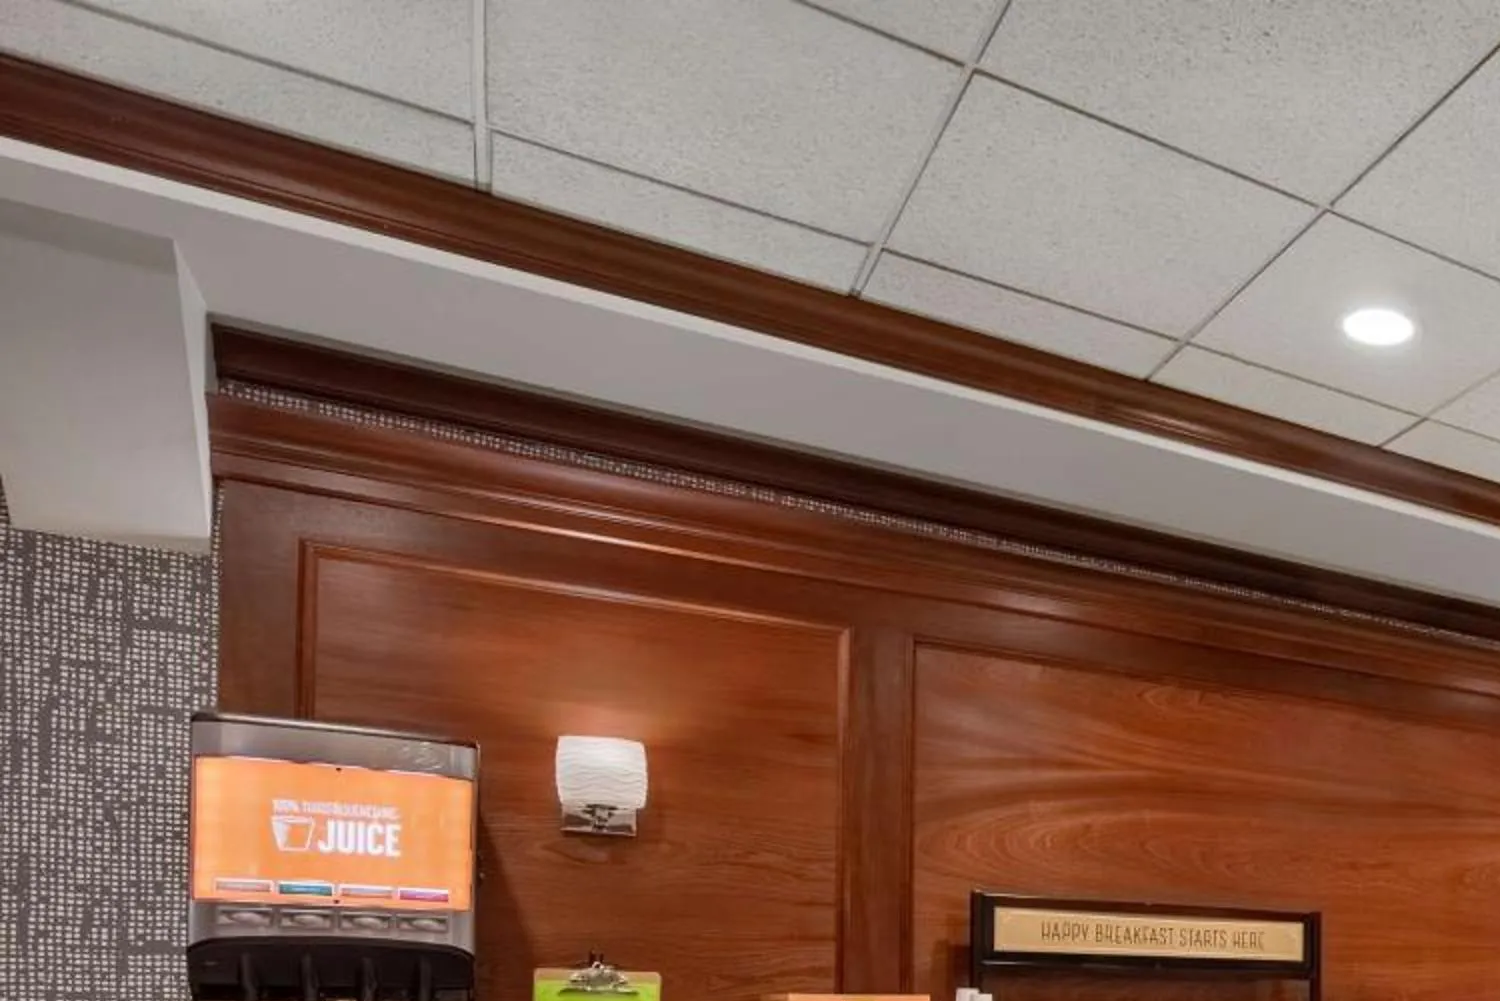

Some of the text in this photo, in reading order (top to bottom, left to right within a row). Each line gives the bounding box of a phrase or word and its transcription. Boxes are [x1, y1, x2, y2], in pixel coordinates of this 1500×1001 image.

[317, 818, 402, 857] JUICE
[1041, 920, 1265, 950] HAPPY BREAKFAST STARTS HERE
